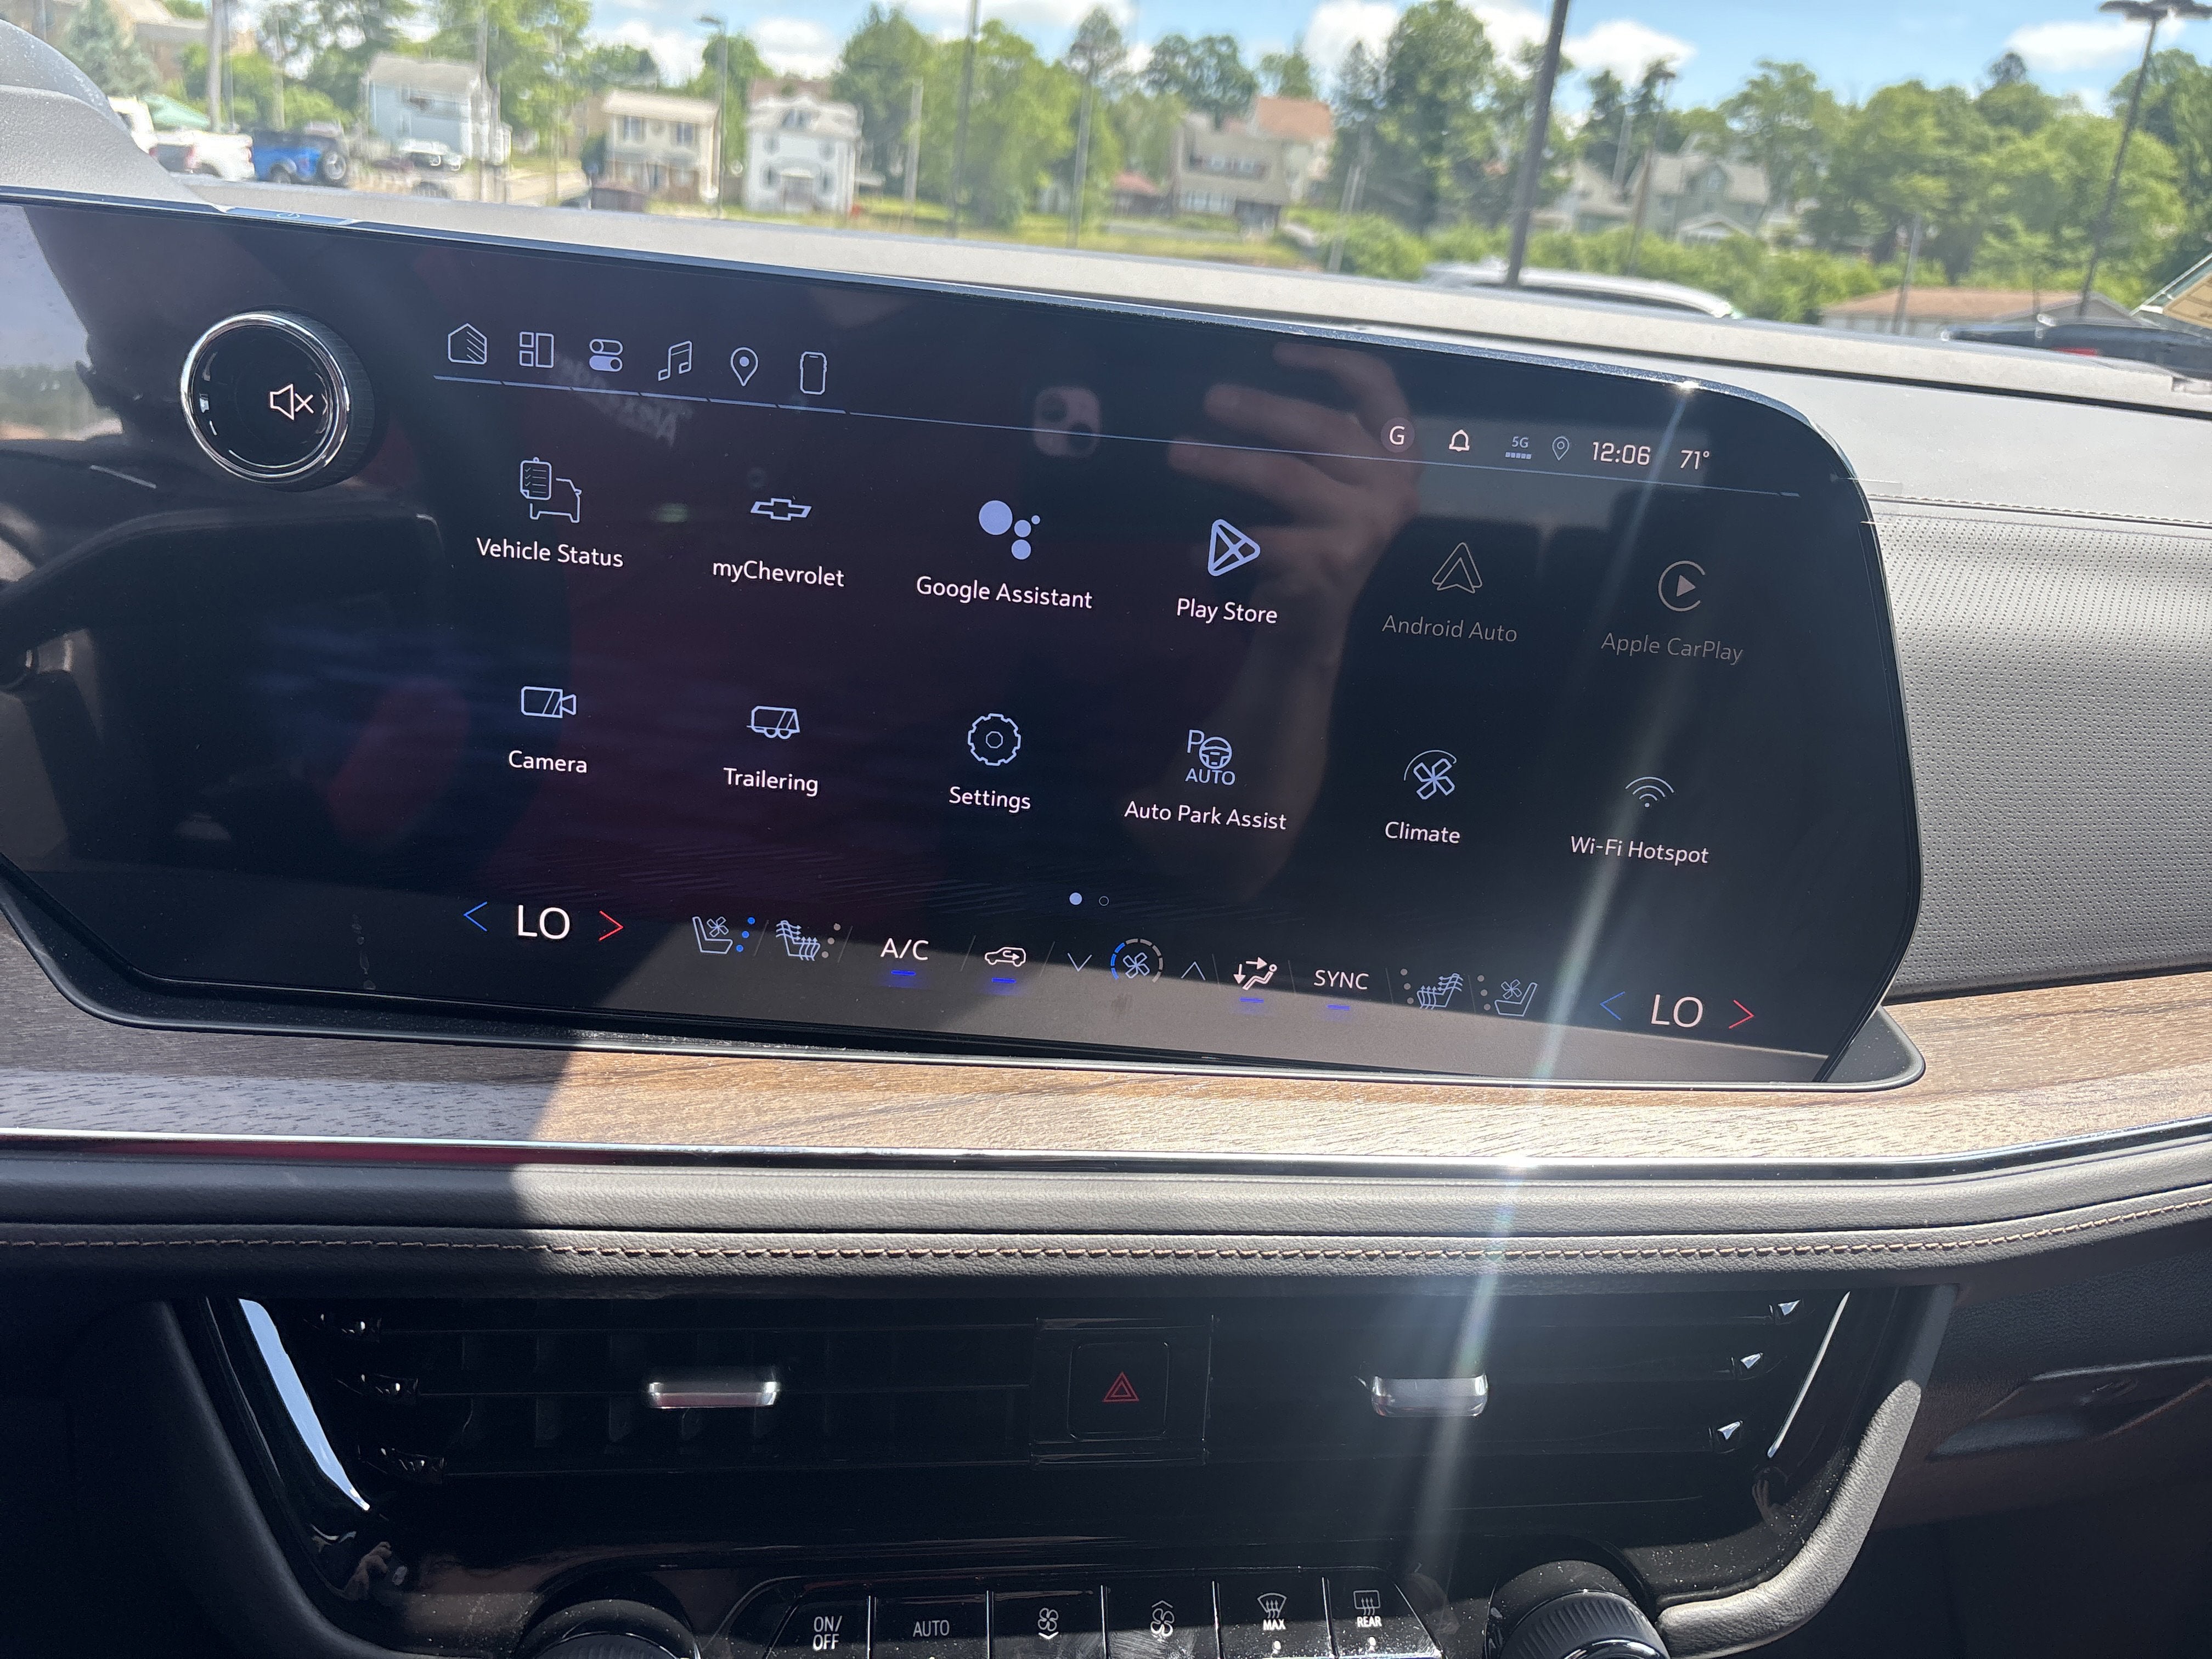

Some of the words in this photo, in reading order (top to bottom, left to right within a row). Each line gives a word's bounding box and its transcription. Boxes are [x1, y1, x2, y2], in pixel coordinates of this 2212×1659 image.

[1389, 425, 1405, 445] G
[1511, 436, 1528, 448] 5G
[1593, 442, 1651, 465] 12:06
[476, 537, 551, 561] Vehicle
[557, 544, 623, 567] Status
[713, 560, 844, 587] myChevrolet
[916, 575, 990, 603] Google
[995, 583, 1092, 609] Assistant
[1177, 598, 1218, 624] Play
[1223, 601, 1278, 624] Store
[1381, 614, 1464, 637] Android
[1468, 622, 1517, 642] Auto
[1601, 633, 1660, 657] Apple
[1667, 637, 1743, 665] CarPlay
[509, 750, 587, 773] Camera
[723, 767, 818, 797] Trailering
[1185, 769, 1235, 786] AUTO
[949, 786, 1031, 814] Settings
[1124, 800, 1171, 821] Auto
[1178, 804, 1221, 825] Park
[1226, 809, 1286, 830] Assist
[1385, 821, 1460, 844] Climate
[1571, 836, 1623, 856] Wi-Fi
[1628, 840, 1709, 866] Hotspot
[518, 905, 570, 940] LO
[880, 938, 929, 961] A/C
[1313, 969, 1369, 990] SYNC
[1651, 994, 1703, 1028] LO
[912, 1620, 950, 1637] AUTO
[1263, 1620, 1286, 1631] MAX
[1356, 1616, 1382, 1628] REAR
[812, 1634, 838, 1651] OFF
